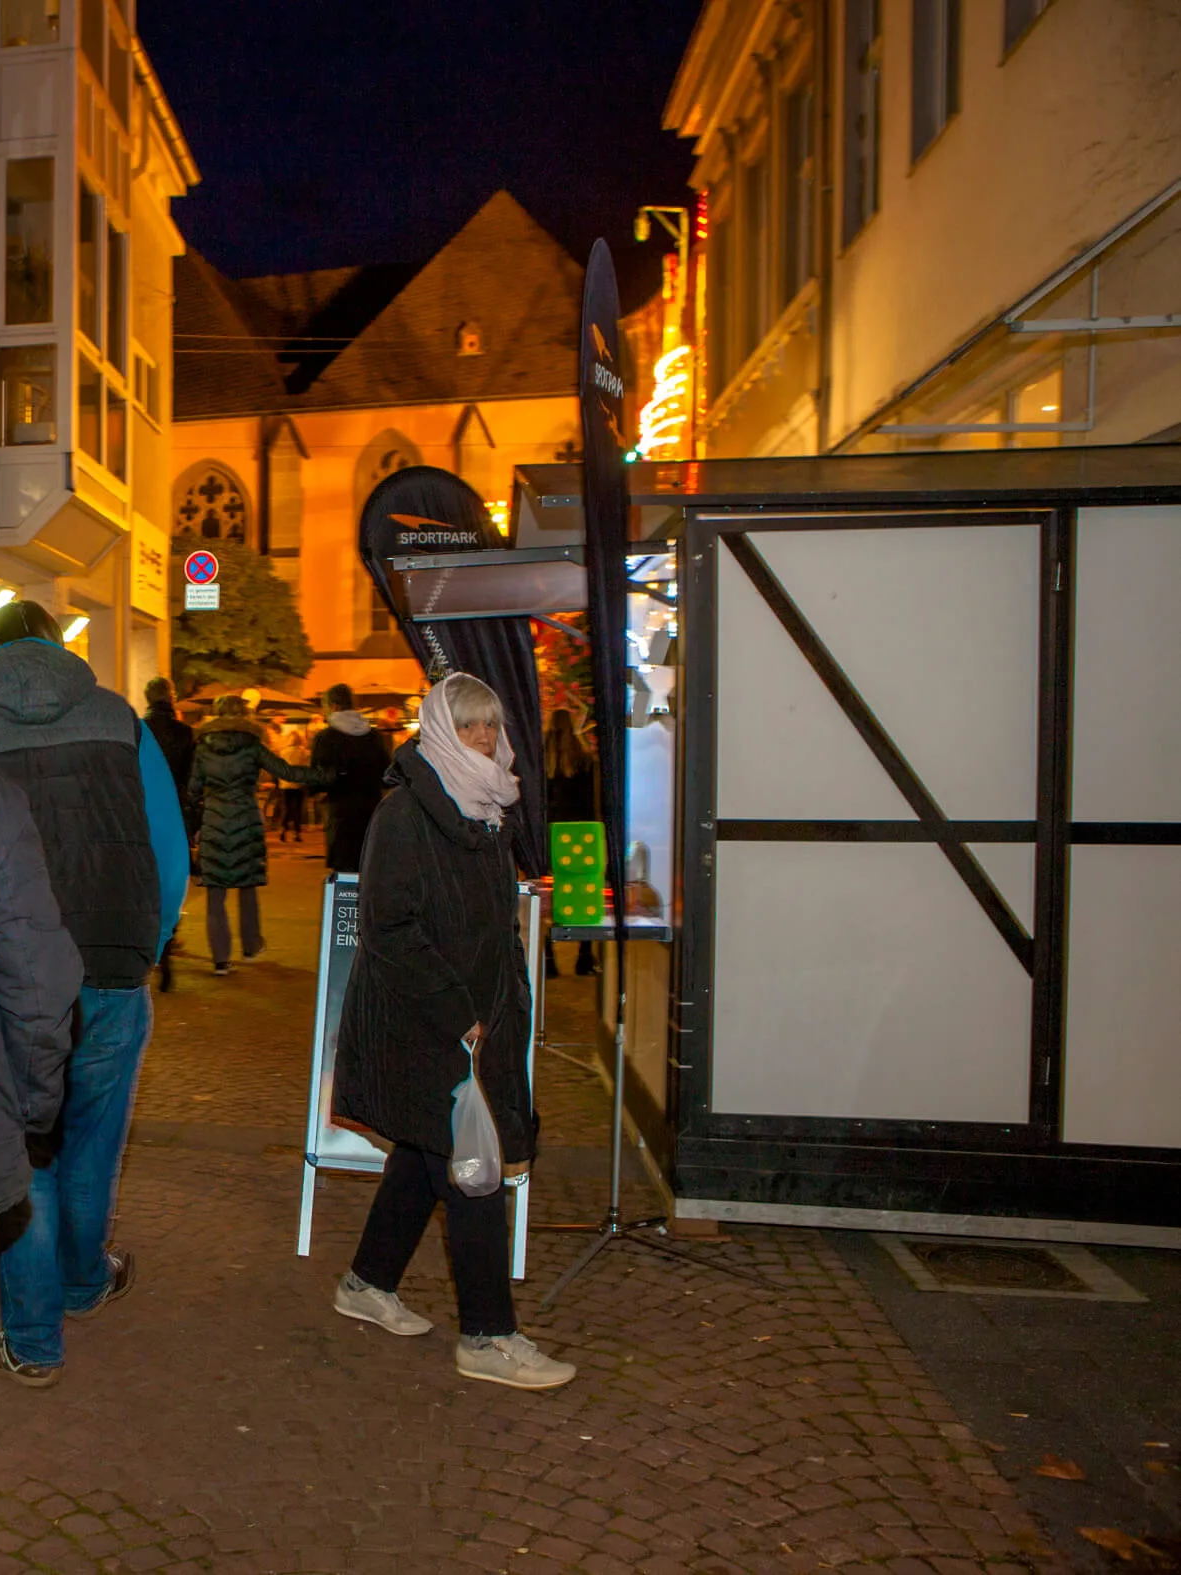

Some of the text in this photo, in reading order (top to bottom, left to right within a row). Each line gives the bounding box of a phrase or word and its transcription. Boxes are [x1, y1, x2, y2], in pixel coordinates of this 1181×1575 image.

[399, 531, 478, 544] SPORTPARK
[337, 906, 360, 919] STE
[337, 920, 359, 933] CH
